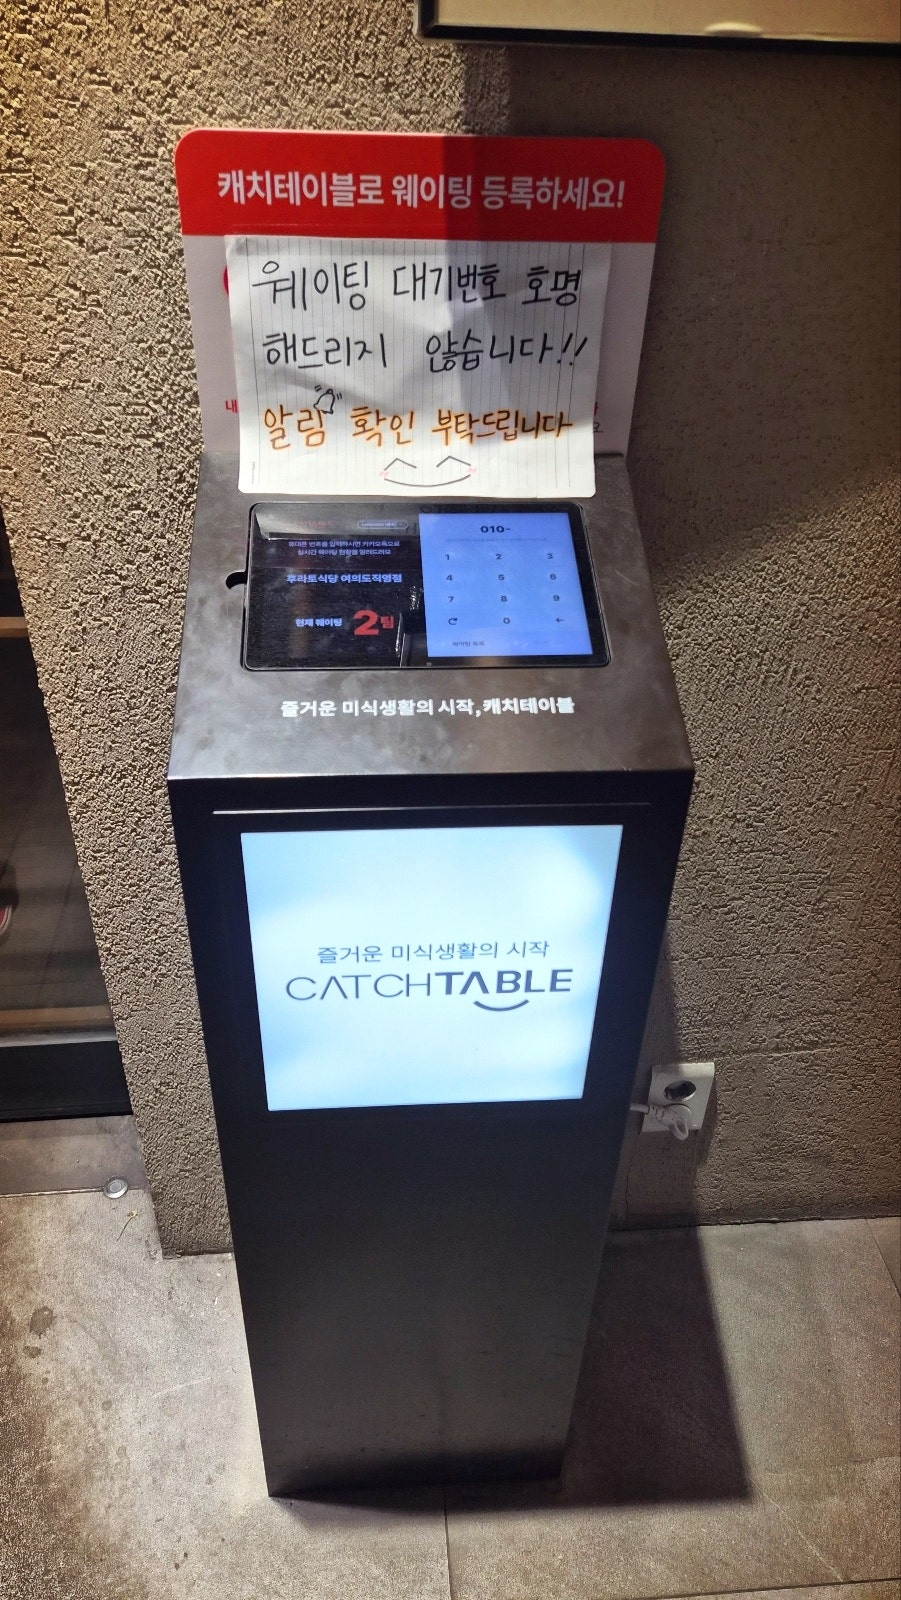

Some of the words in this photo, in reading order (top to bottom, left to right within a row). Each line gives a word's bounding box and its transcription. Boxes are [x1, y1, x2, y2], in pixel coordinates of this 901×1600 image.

[217, 169, 384, 208] 캐치테이블로
[391, 172, 473, 210] 웨이팅
[480, 175, 625, 211] 등록하세요!
[252, 260, 369, 311] 웨이팅
[393, 261, 507, 303] 대기번호
[521, 265, 583, 307] 호명
[262, 332, 388, 369] 해드리지
[425, 328, 588, 374] 않습니다!!
[263, 404, 326, 451] 알림
[350, 405, 416, 448] 확인
[431, 408, 574, 447] 부탁드립니다
[480, 525, 511, 534] 010-
[503, 617, 510, 625] 0
[281, 701, 337, 717] 즐거운
[342, 699, 434, 716] 미식생활의
[317, 945, 383, 964] 즐거운
[392, 941, 498, 962] 미식생활의
[506, 940, 550, 958] 시작
[286, 969, 573, 1001] CATCHTABLE
